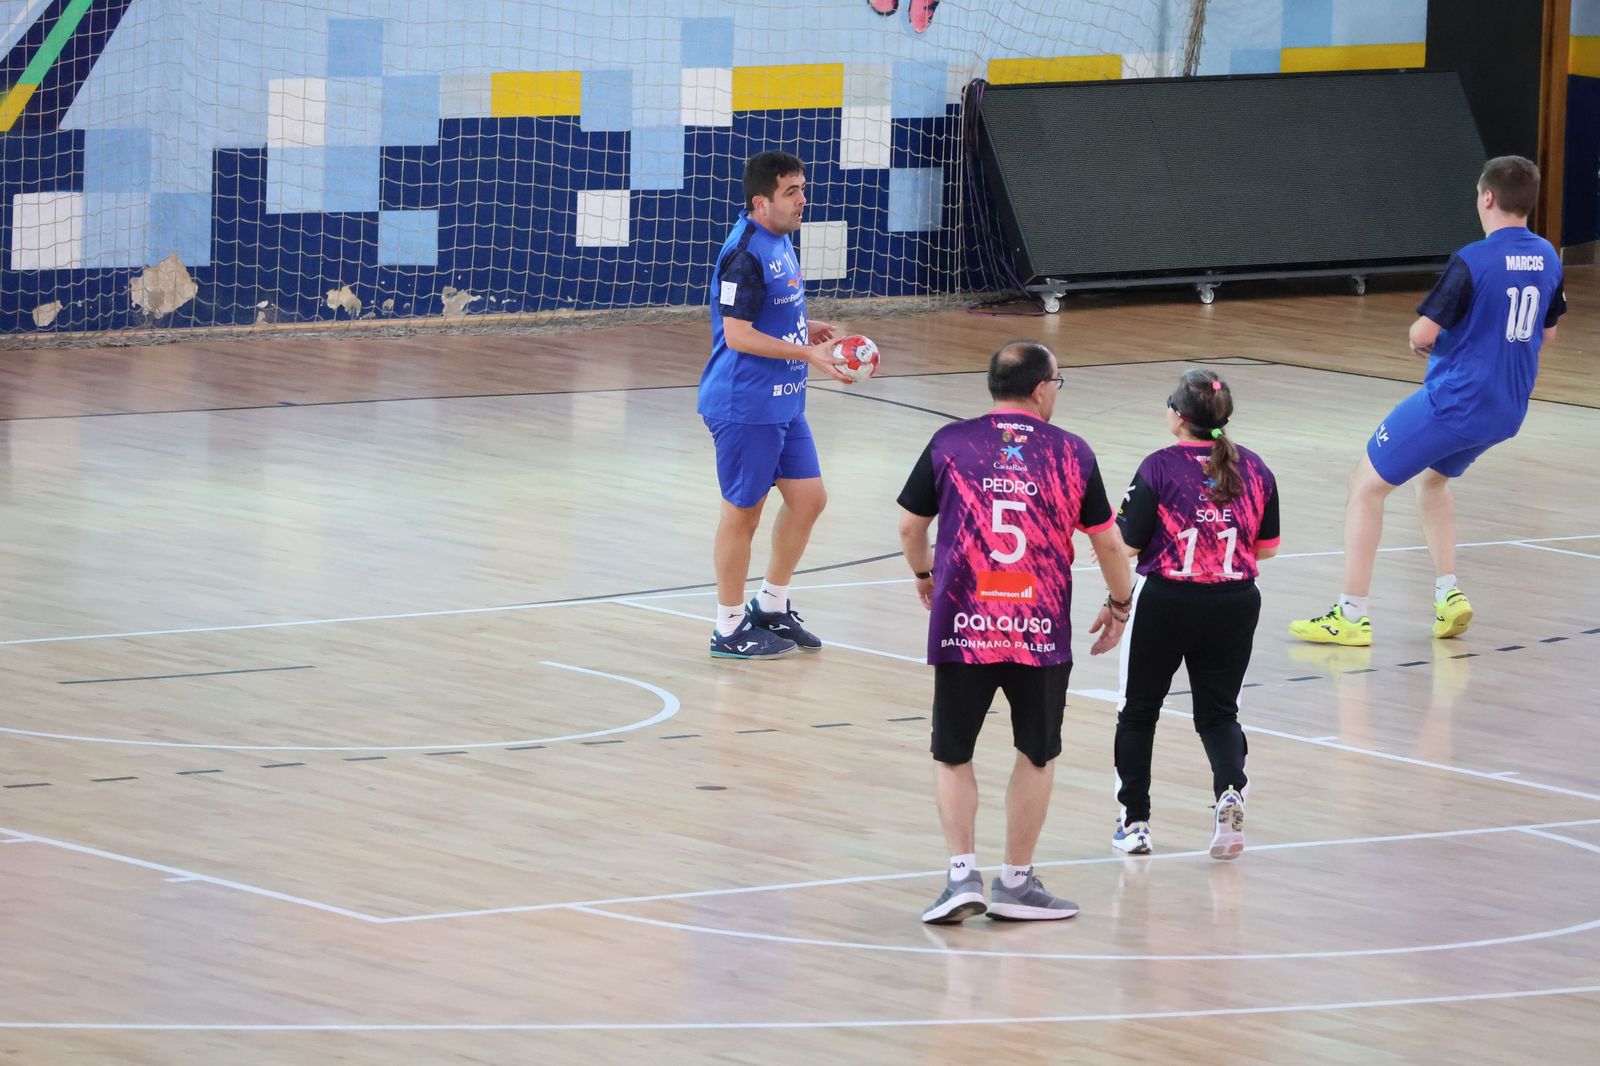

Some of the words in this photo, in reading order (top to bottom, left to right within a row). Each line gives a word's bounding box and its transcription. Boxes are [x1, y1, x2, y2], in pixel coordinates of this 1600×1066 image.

[1505, 255, 1544, 271] MARCOS
[1506, 285, 1541, 343] 10
[982, 477, 1038, 496] PEDRO
[1195, 509, 1232, 523] SOLE
[989, 499, 1028, 565] 5
[1169, 526, 1244, 579] 11
[980, 589, 1020, 598] motherson
[941, 637, 1011, 649] BALONMANO
